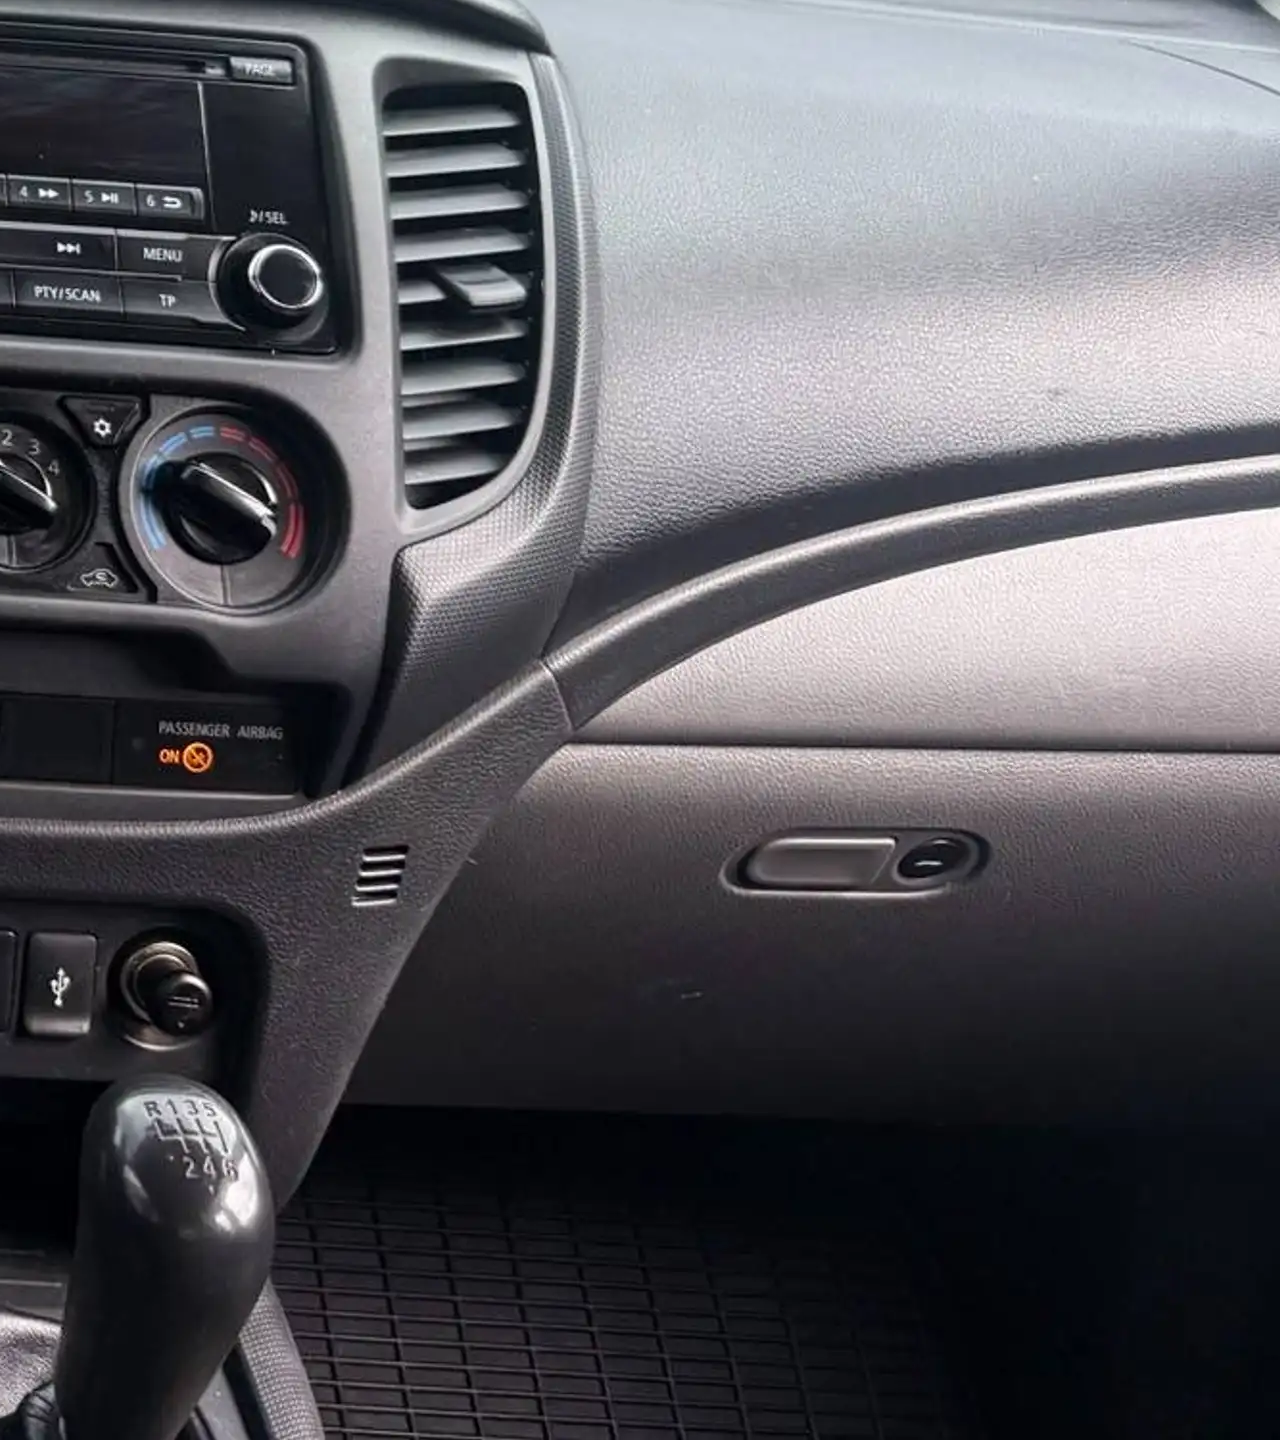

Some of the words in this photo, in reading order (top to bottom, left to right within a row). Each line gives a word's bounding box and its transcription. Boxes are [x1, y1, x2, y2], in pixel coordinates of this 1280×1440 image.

[19, 185, 28, 198] 4
[84, 190, 93, 204] 5
[146, 194, 156, 208] 6
[143, 247, 183, 263] MENU
[33, 285, 101, 302] PTY/SCAN
[158, 293, 176, 308] TP
[1, 429, 13, 447] 2
[28, 438, 41, 455] 3
[48, 460, 60, 476] 4
[158, 720, 230, 738] PASSENGER
[237, 725, 284, 740] AIRBAG
[160, 748, 180, 763] ON
[143, 1101, 162, 1117] R
[167, 1099, 177, 1115] 1
[183, 1100, 199, 1115] 3
[202, 1102, 217, 1117] 5
[183, 1156, 199, 1179] 2
[203, 1155, 217, 1179] 4
